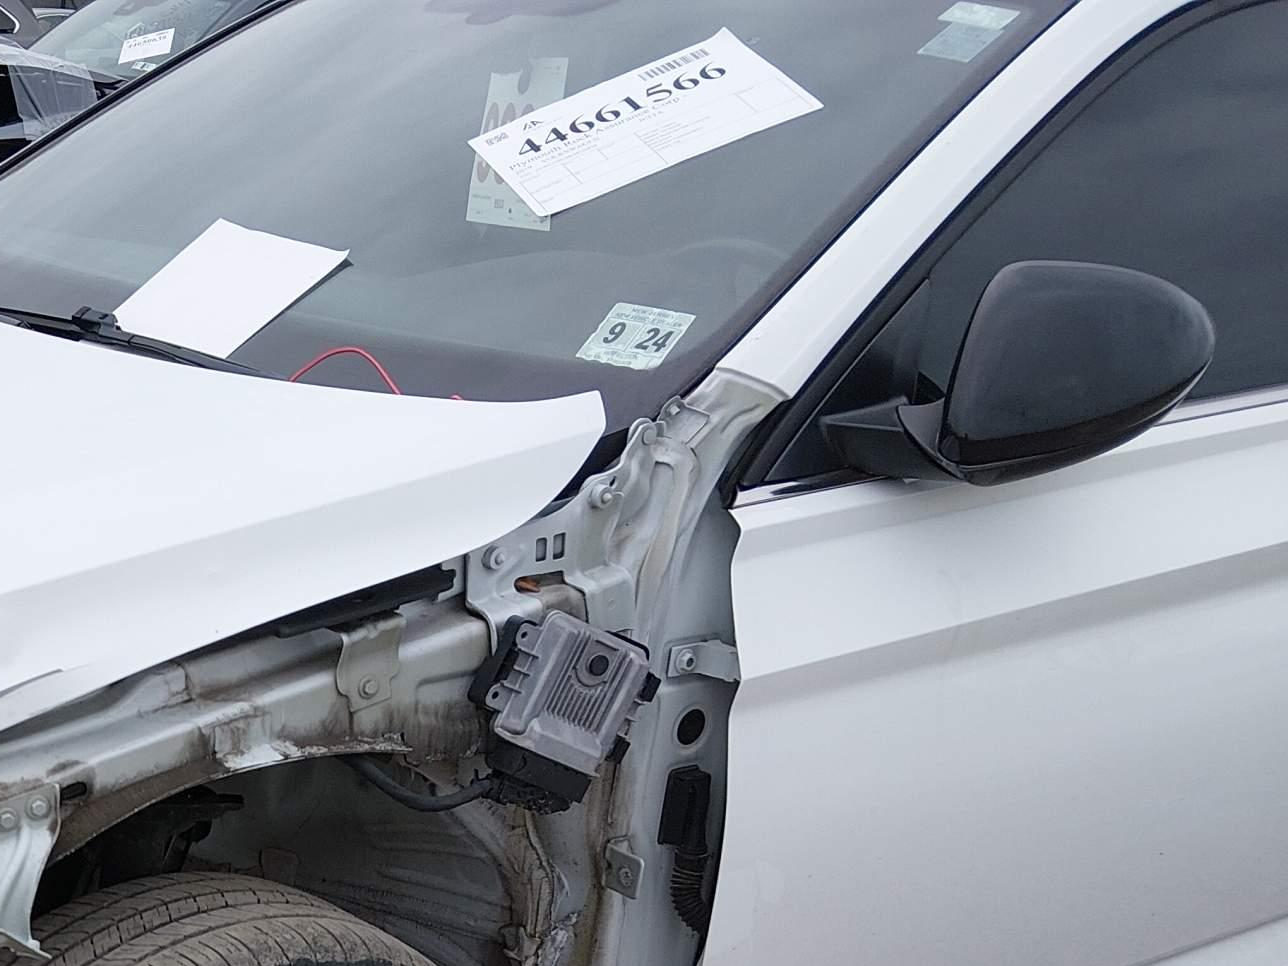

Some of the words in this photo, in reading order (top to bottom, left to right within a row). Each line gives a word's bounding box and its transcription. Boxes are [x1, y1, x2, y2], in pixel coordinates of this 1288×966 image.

[518, 61, 727, 155] 44661566
[603, 322, 626, 344] 9
[634, 327, 675, 352] 24
